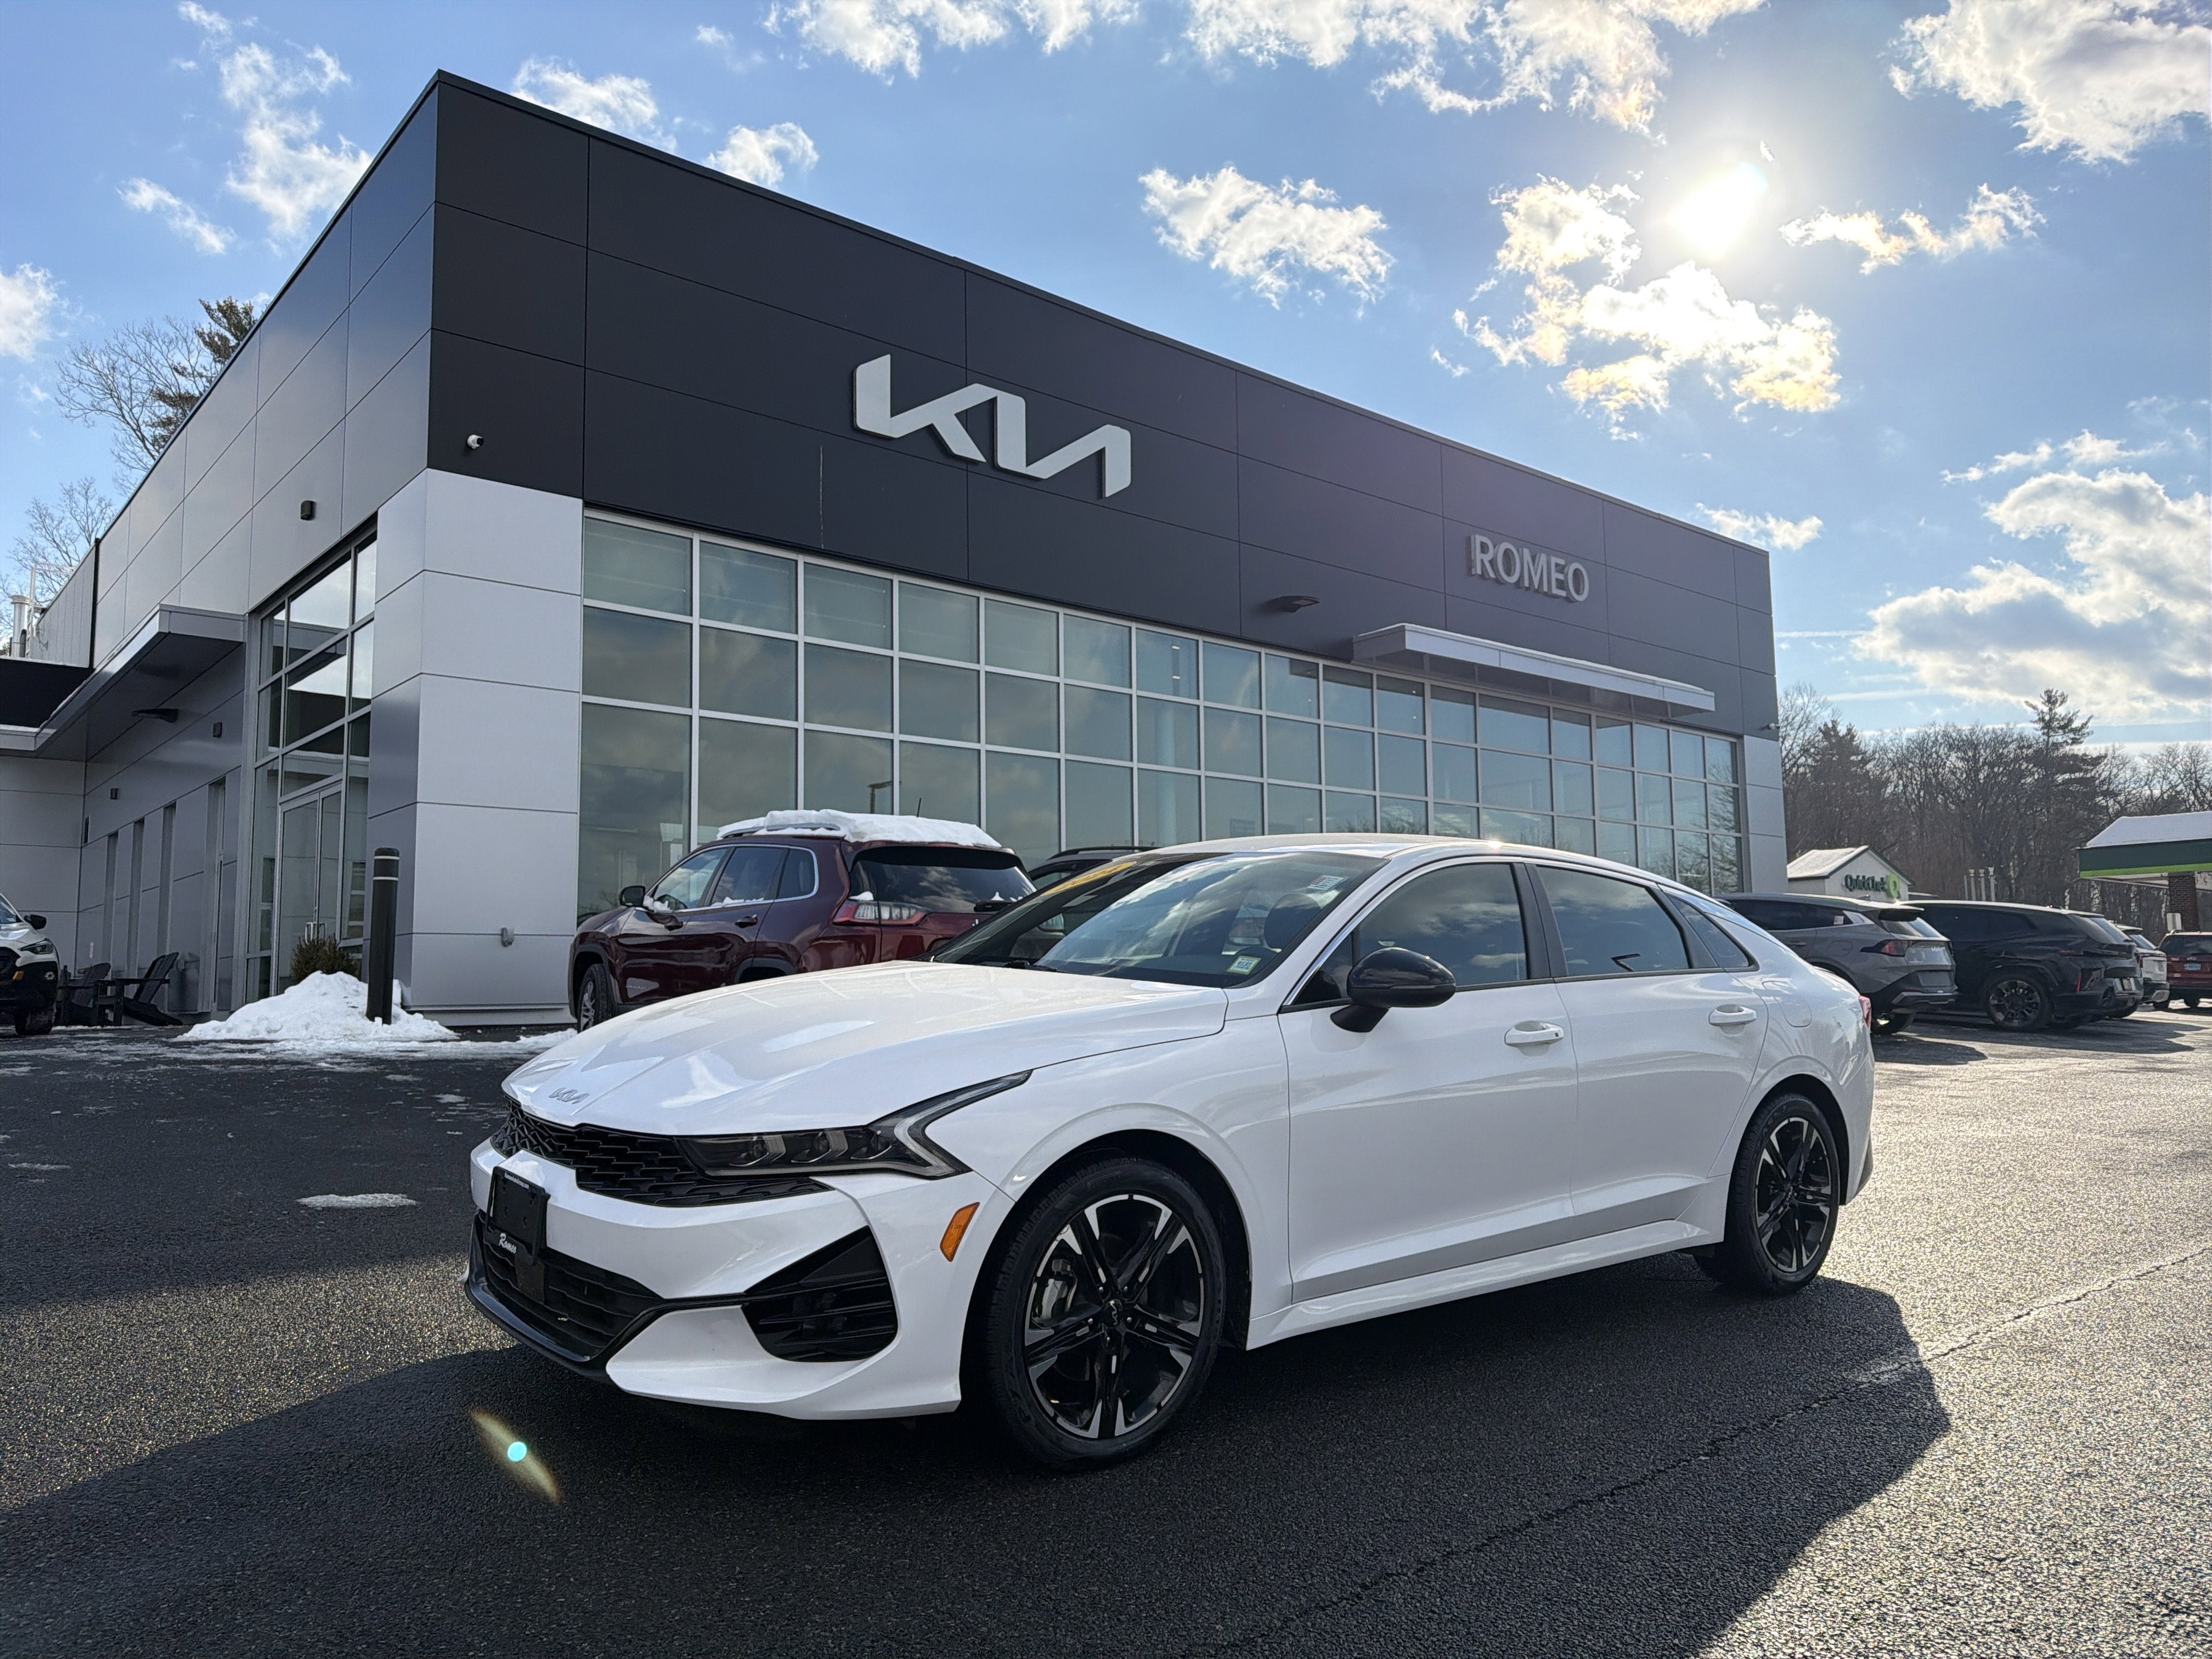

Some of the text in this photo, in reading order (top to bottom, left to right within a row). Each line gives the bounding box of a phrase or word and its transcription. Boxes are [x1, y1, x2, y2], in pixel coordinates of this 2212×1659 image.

[854, 354, 1131, 498] KIA
[1470, 534, 1589, 602] ROMEO
[549, 1087, 590, 1104] KIA
